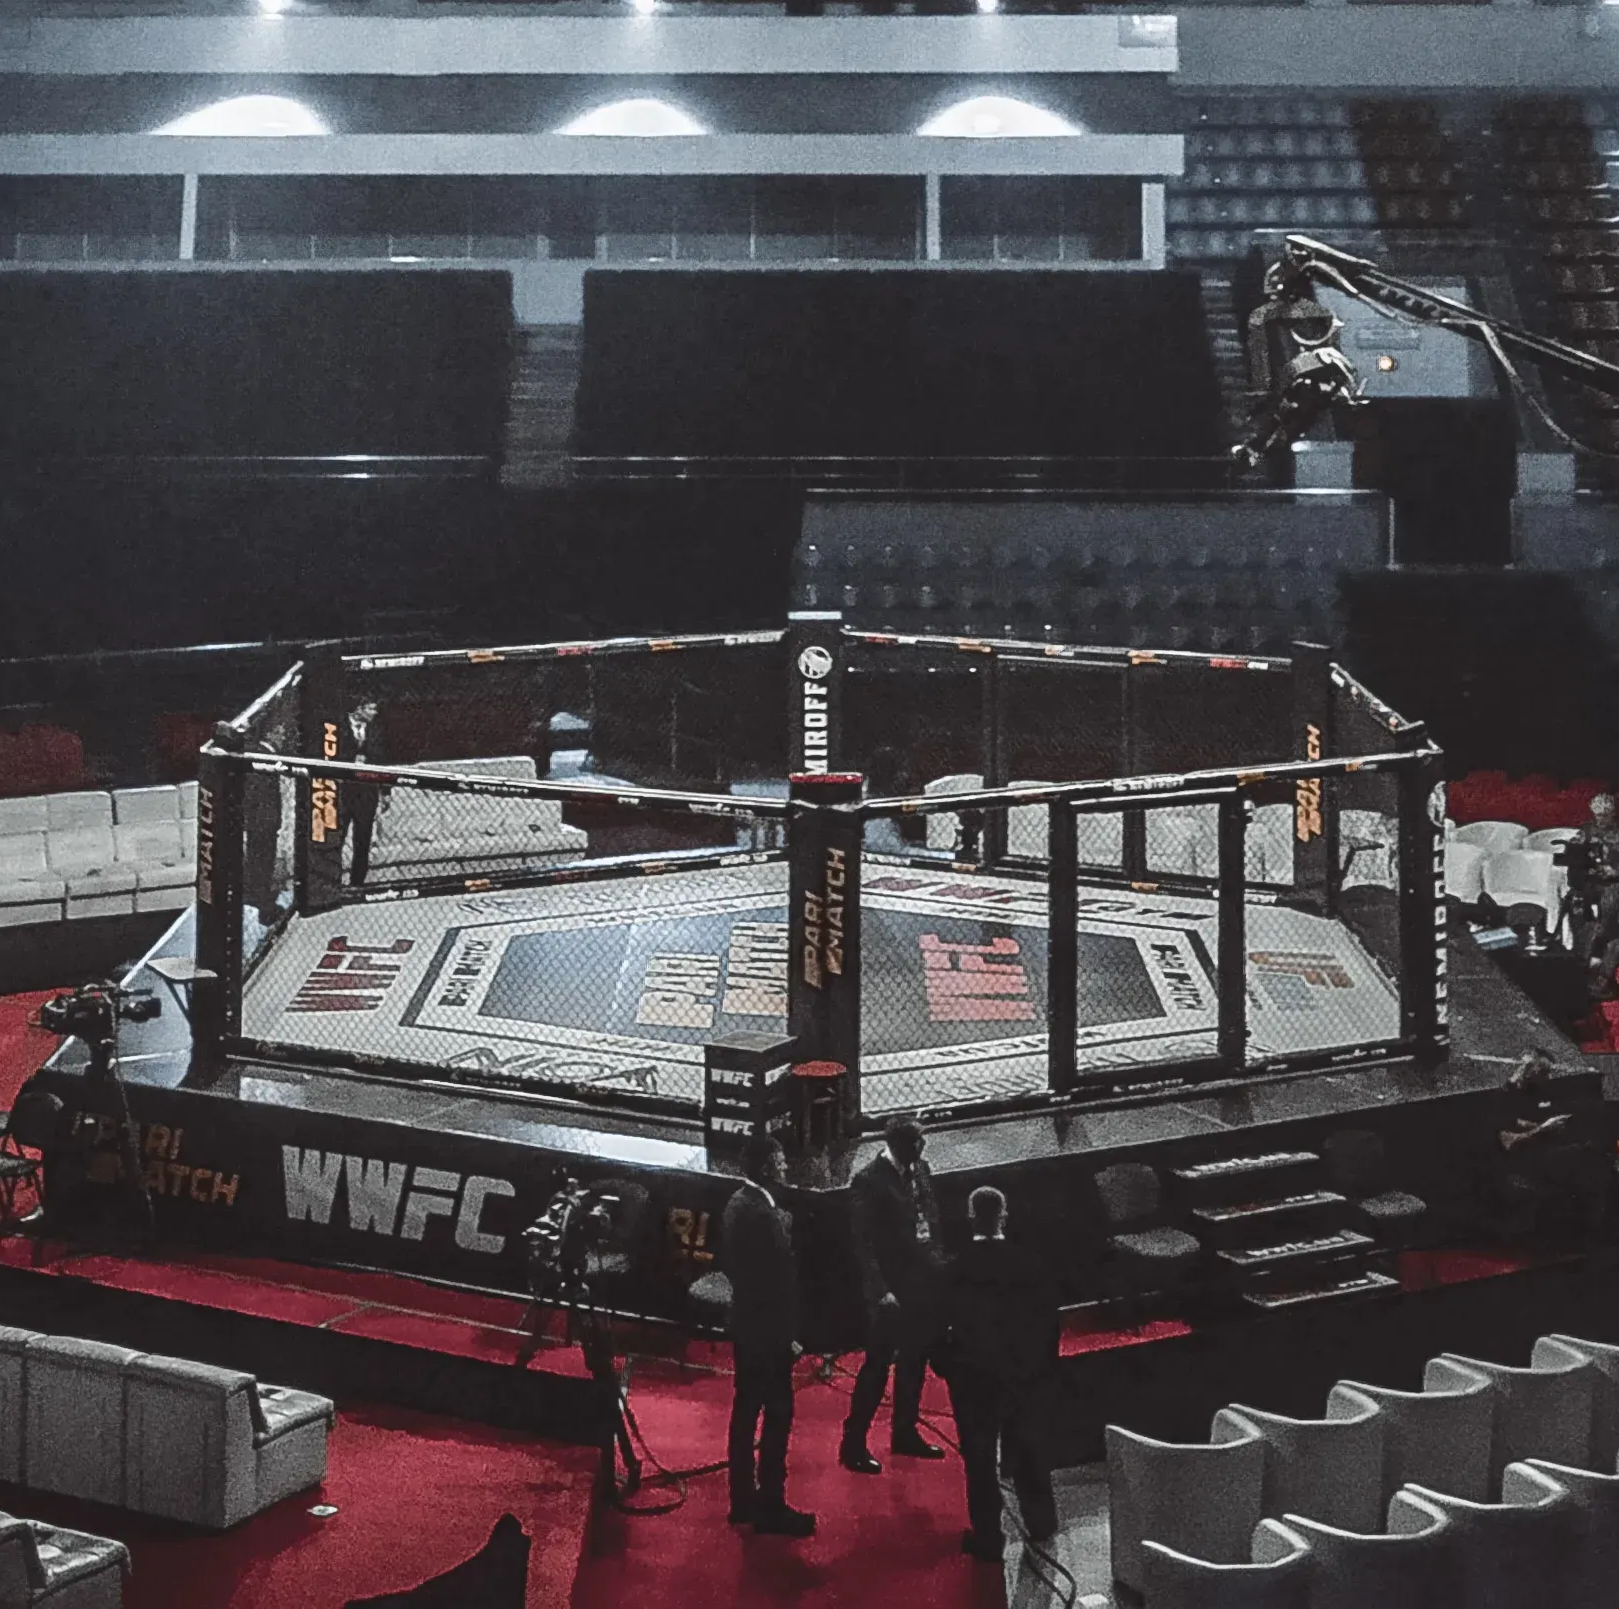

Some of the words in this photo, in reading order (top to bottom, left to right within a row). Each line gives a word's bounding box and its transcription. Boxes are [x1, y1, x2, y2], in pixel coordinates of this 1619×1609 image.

[804, 889, 823, 990] PARI
[825, 846, 846, 976] MATCH
[285, 935, 416, 1012] WWFC
[636, 951, 720, 1028] PARI
[281, 1144, 516, 1254] WWFC
